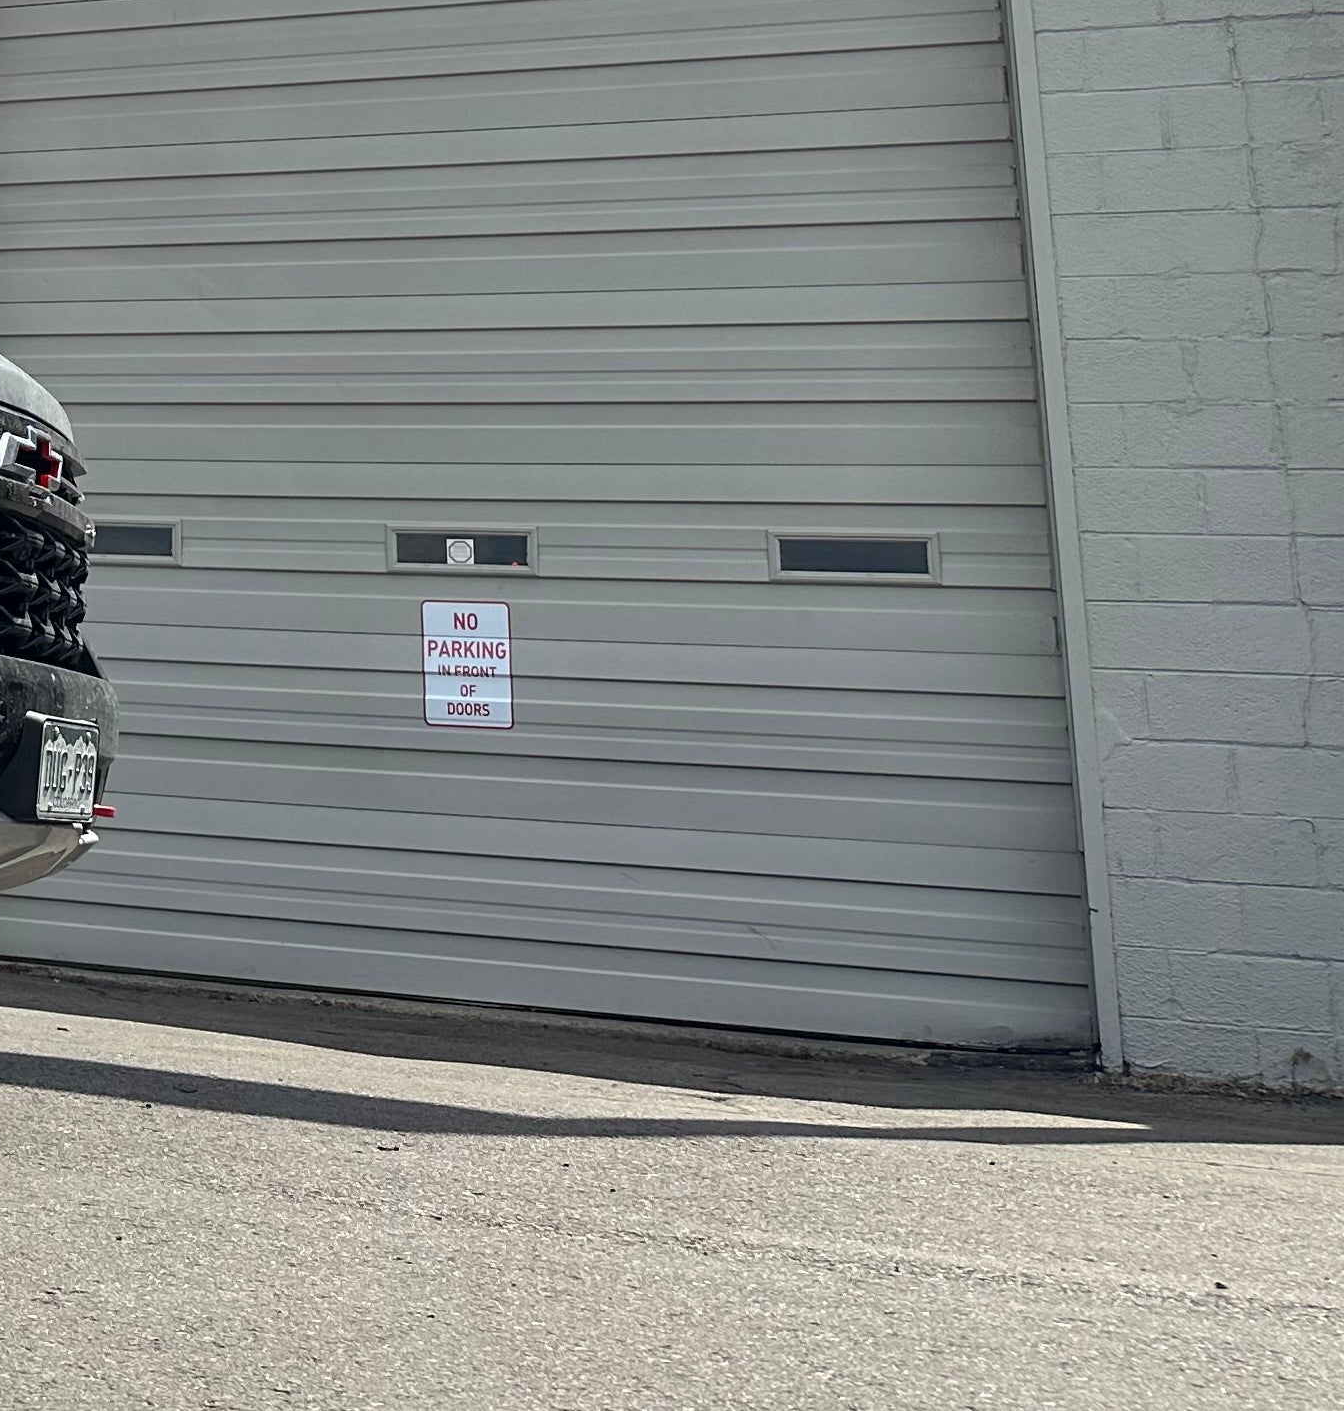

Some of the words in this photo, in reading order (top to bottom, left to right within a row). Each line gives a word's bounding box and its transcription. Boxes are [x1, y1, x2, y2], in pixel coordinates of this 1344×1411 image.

[453, 612, 478, 630] NO
[427, 640, 507, 660] PARKING
[437, 664, 451, 677] IN
[454, 665, 497, 678] FRONT
[460, 684, 477, 698] OF
[447, 702, 490, 717] DOORS
